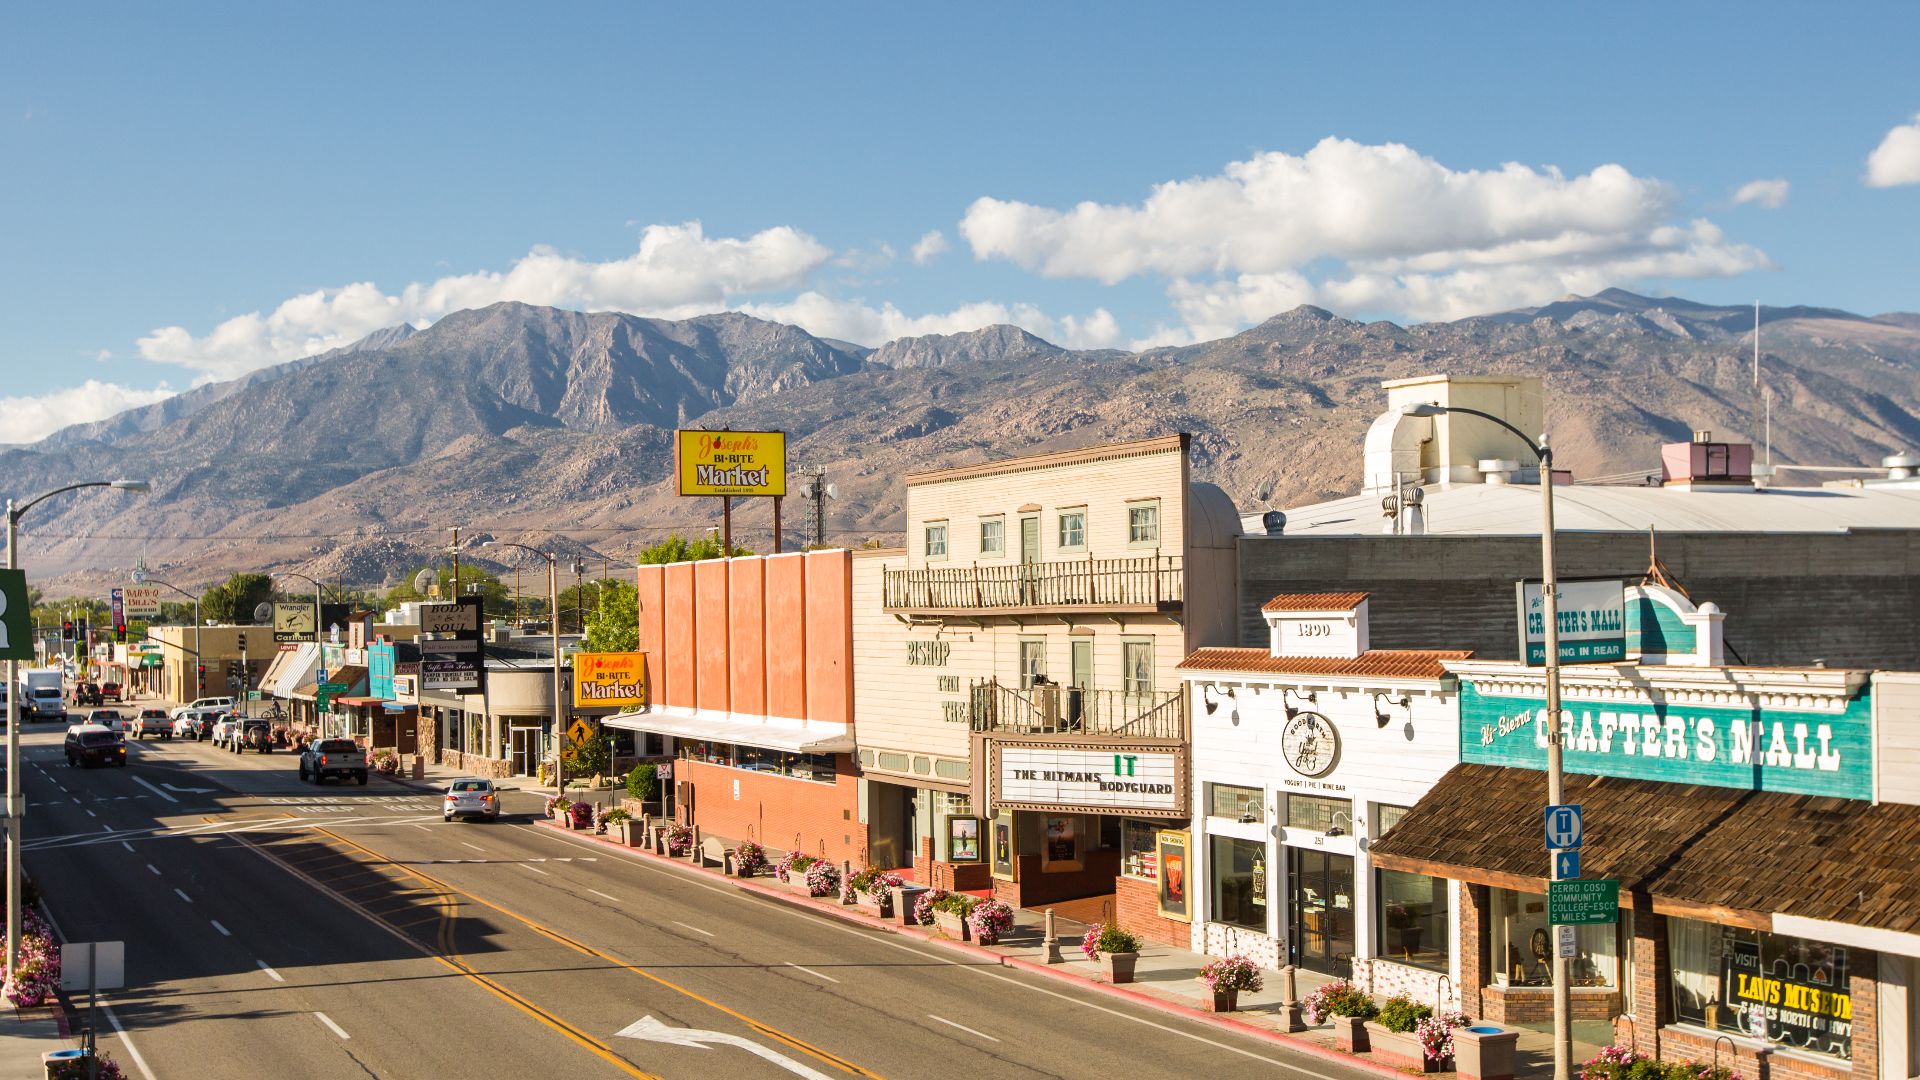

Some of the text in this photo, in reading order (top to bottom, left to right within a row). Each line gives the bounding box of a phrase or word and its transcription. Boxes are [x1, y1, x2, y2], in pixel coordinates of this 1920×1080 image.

[696, 463, 769, 487] Market
[280, 604, 310, 614] Wrangler
[431, 604, 467, 613] BODY
[432, 623, 467, 632] SOUL
[1529, 609, 1621, 635] CRTER'S MALL
[906, 640, 950, 666] BISHOP
[1533, 645, 1619, 658] PAING IN REAR
[581, 679, 643, 700] Market
[1480, 709, 1841, 772] Hi-Sierra CRAFTER'S MALL
[1114, 754, 1138, 777] IT
[1014, 769, 1101, 783] THE HITMANS
[1099, 781, 1173, 795] BODYGUARD
[1284, 779, 1346, 792] YOGURT PIE WINE BAR
[1552, 883, 1606, 893] CERRO COSO
[1552, 893, 1602, 903] COMMUNITY
[1552, 902, 1615, 912] COLLEGE-ESCC
[1552, 912, 1587, 922] 5 MILES
[1735, 952, 1758, 968] VISIT
[1737, 974, 1853, 1020] LAWS MUSEUM
[1780, 1009, 1811, 1028] NORTH
[1829, 1020, 1853, 1037] HWY
